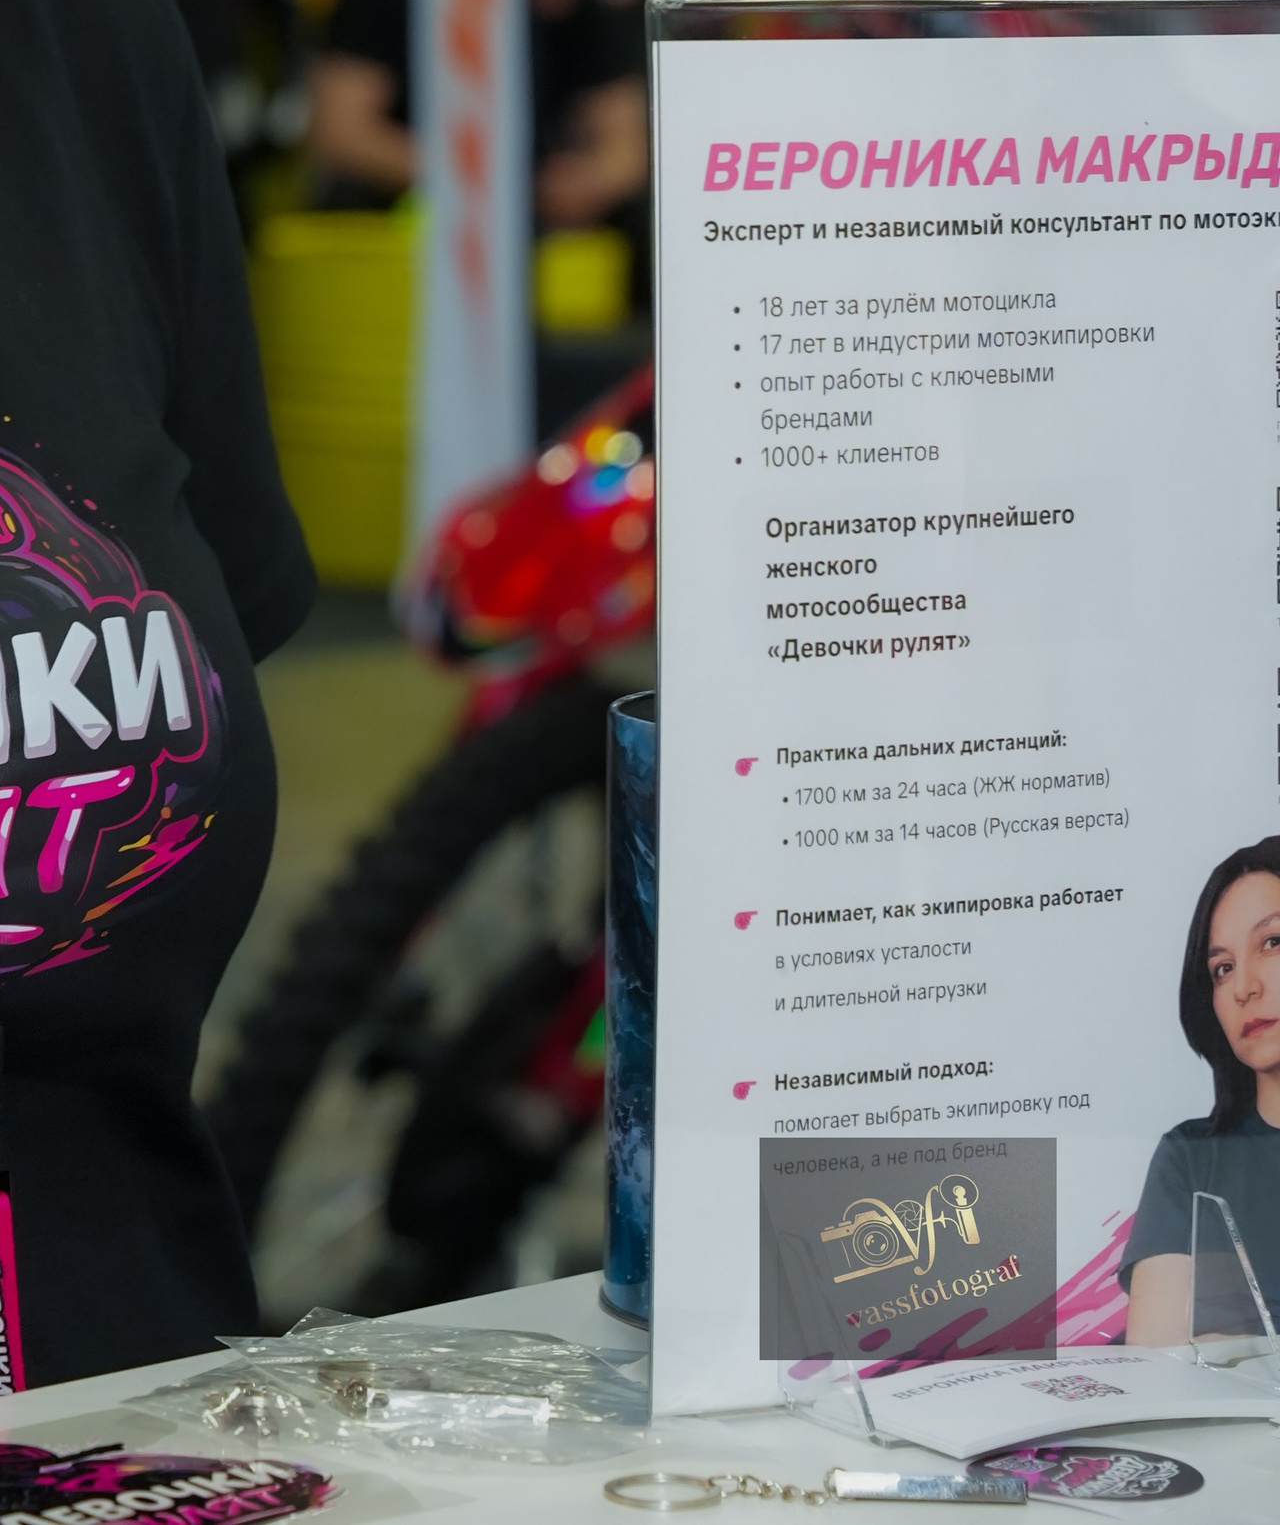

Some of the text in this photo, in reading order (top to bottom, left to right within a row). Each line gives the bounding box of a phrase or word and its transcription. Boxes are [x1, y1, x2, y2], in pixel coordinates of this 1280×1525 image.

[703, 131, 1280, 192] ВЕРОНИКА МАКРЫД
[704, 220, 805, 246] Эксперт
[812, 223, 827, 240] и
[835, 212, 1003, 239] независимый
[1010, 214, 1153, 238] консультант
[1159, 213, 1187, 230] по
[759, 292, 1057, 320] 18 лет за рулём мотоцикла
[759, 326, 1155, 356] 17 лет в индустрии мотоэкипировки
[760, 366, 1054, 396] опыт работы с ключевыми
[761, 408, 873, 435] брендами
[761, 445, 940, 468] 1000+ клиентов
[765, 505, 1075, 543] Организатор крупнейшего
[766, 558, 878, 579] женского
[766, 592, 967, 620] мотосообщества
[767, 634, 971, 663] «Девочки рулят»
[776, 729, 1067, 769] Практика дальних дистанций:
[795, 767, 1110, 806] 1700 км за 24 часа (ЖЖ норматив)
[795, 807, 1130, 848] 1000 км за 14 часов (Русская верста)
[776, 887, 1124, 927] Понимает, как экипировка работает
[775, 941, 972, 973] в условиях усталости
[775, 981, 987, 1013] и длительной нагрузки
[774, 1060, 994, 1091] Независимый подход:
[774, 1093, 1091, 1134] помогает выбрать экипировку под
[773, 1141, 1008, 1175] человека, а не под бренд
[892, 1369, 1007, 1401] ВЕРОНИКА
[1011, 1355, 1150, 1375] МАКРЫДОВА
